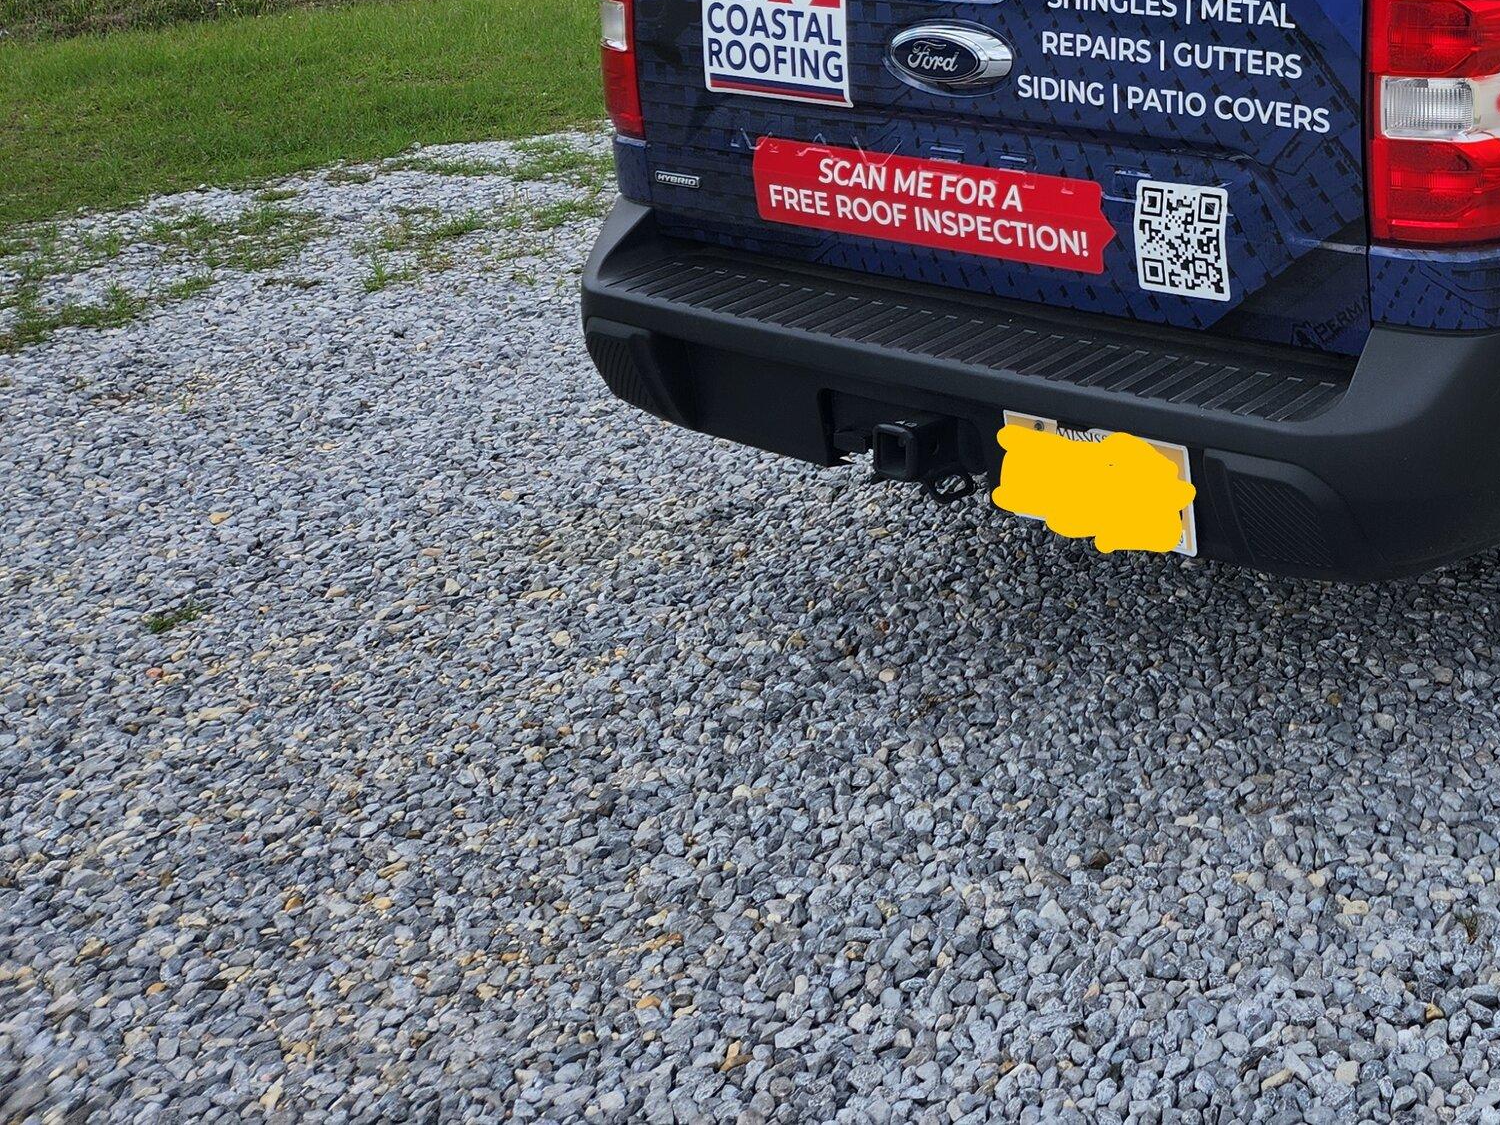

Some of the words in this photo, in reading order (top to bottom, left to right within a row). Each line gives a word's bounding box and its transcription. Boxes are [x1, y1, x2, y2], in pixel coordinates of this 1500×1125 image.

[707, 1, 842, 47] COASTAL
[708, 37, 844, 83] ROOFING
[907, 41, 960, 72] Ford
[1041, 31, 1152, 64] REPAIRS
[1173, 41, 1303, 79] GUTTERS
[1017, 74, 1106, 107] SIDING
[1127, 86, 1207, 117] PATIO
[1214, 95, 1330, 134] COVERS
[658, 173, 696, 186] HYBRID
[818, 158, 887, 191] SCAN
[894, 168, 934, 198] ME
[940, 176, 997, 208] FOR
[1002, 184, 1023, 212] A
[768, 184, 831, 216] FREE
[835, 194, 907, 227] ROOF
[914, 206, 1088, 256] INSPECTION!
